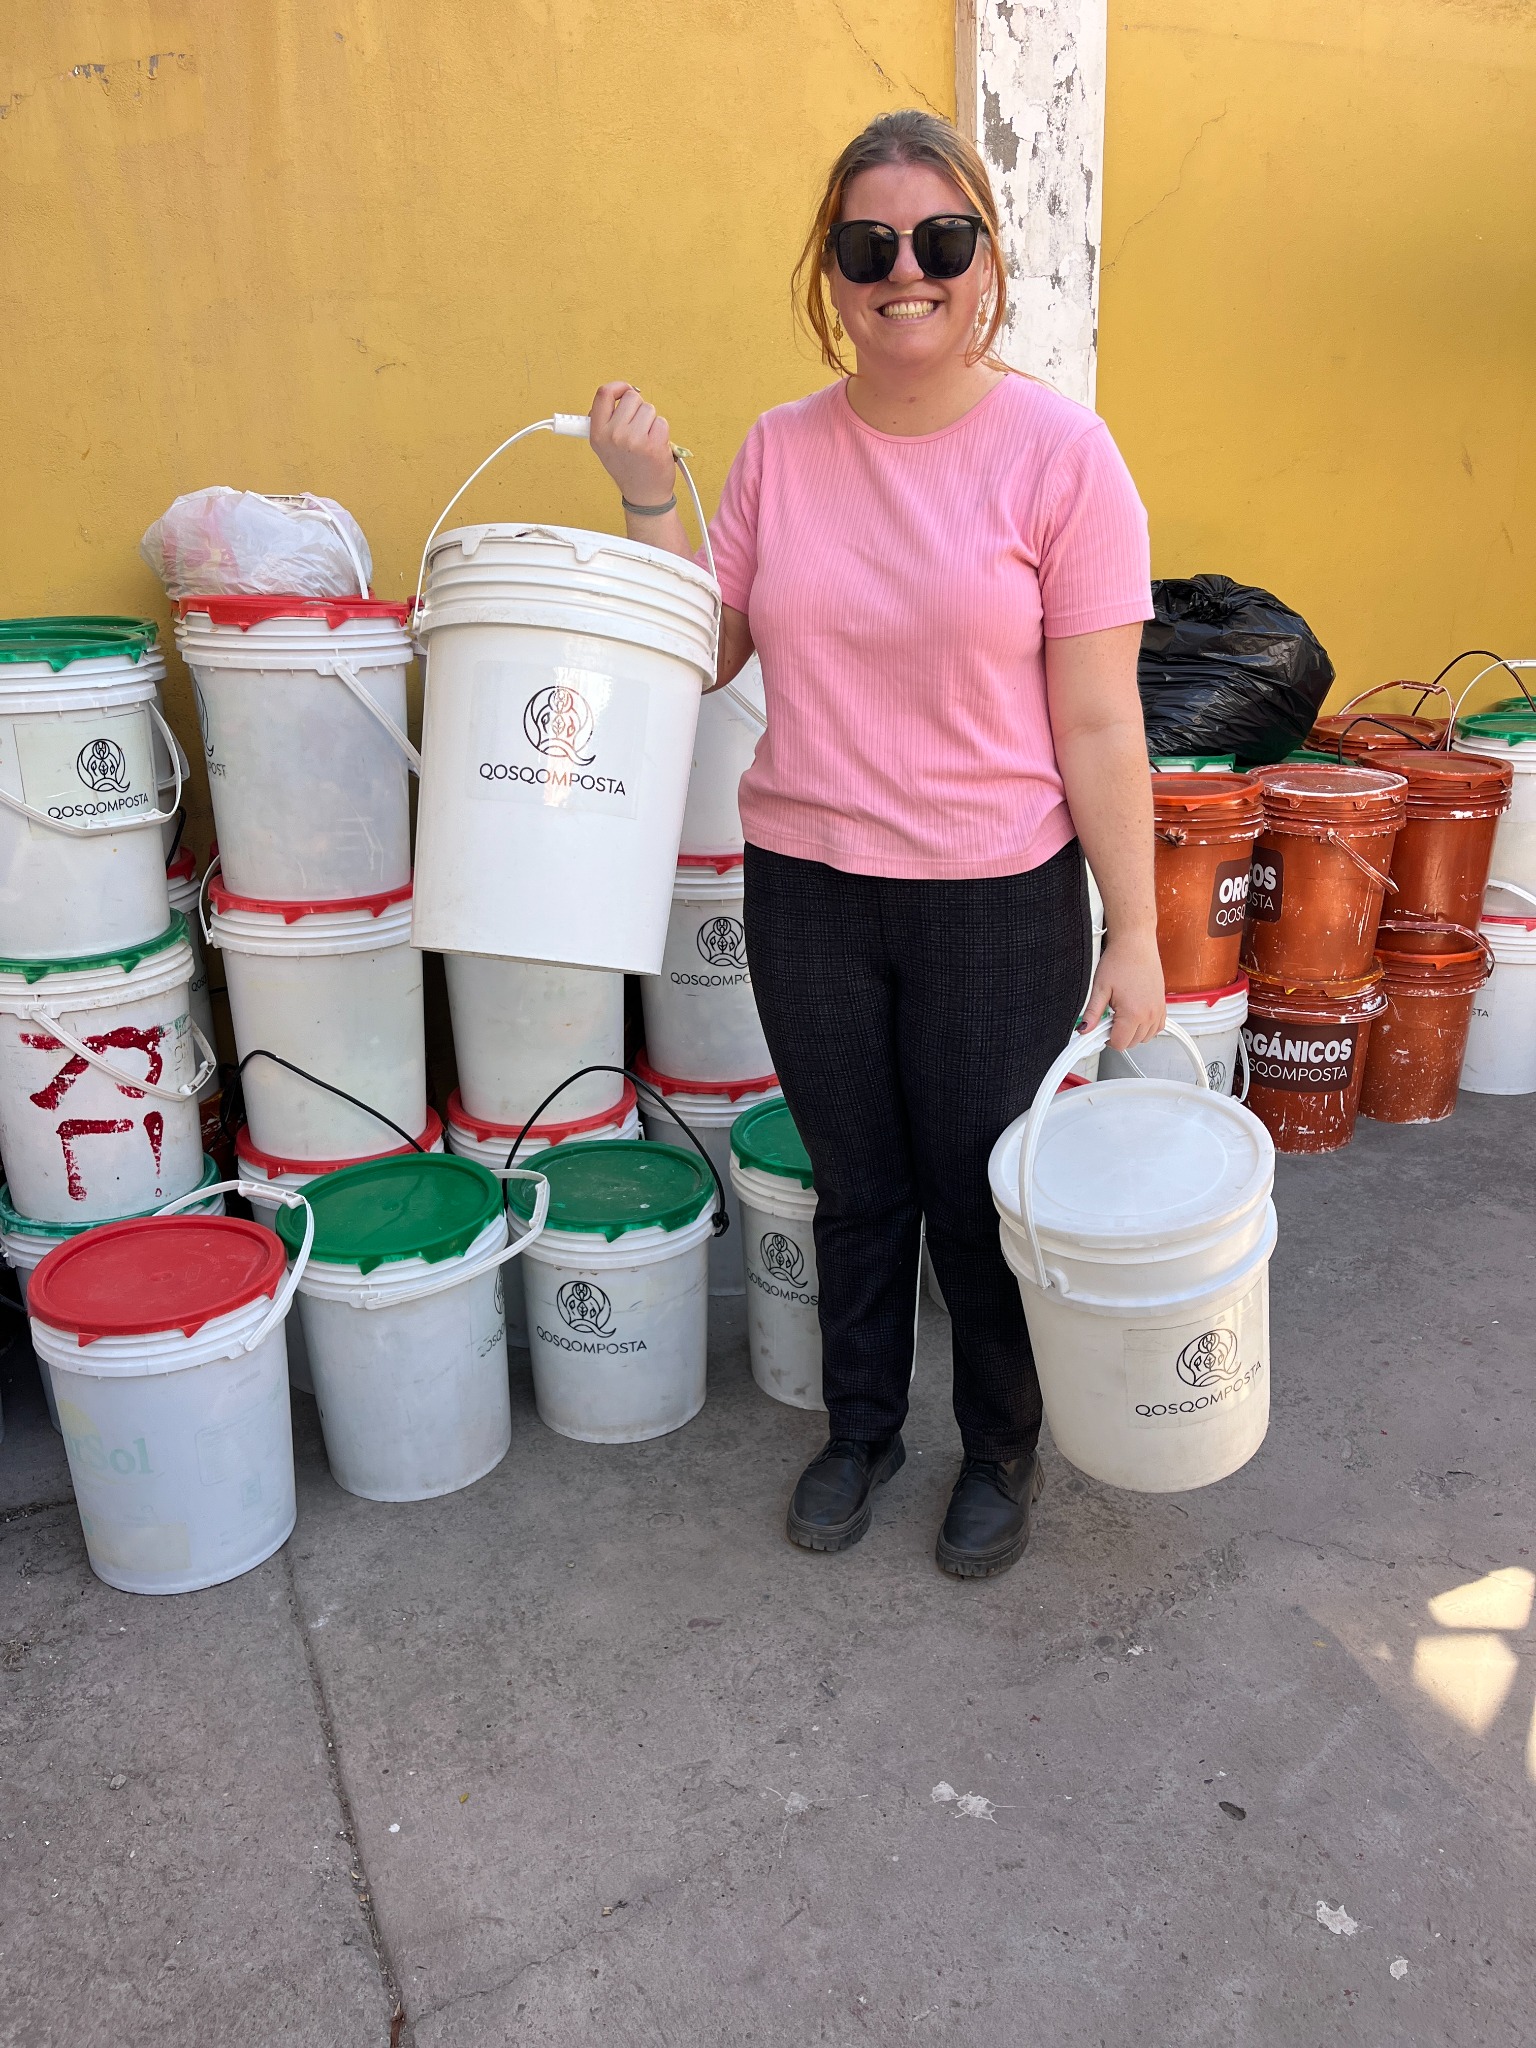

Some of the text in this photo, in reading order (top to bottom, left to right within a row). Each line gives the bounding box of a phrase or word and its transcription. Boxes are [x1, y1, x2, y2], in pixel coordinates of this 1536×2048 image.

[479, 763, 626, 796] QOSQOMPOSTA
[48, 793, 149, 819] QOSQOMPOSTA
[537, 1325, 648, 1355] QOSQOMPOSTA
[1135, 1360, 1262, 1417] QOSQOMPOSTA
